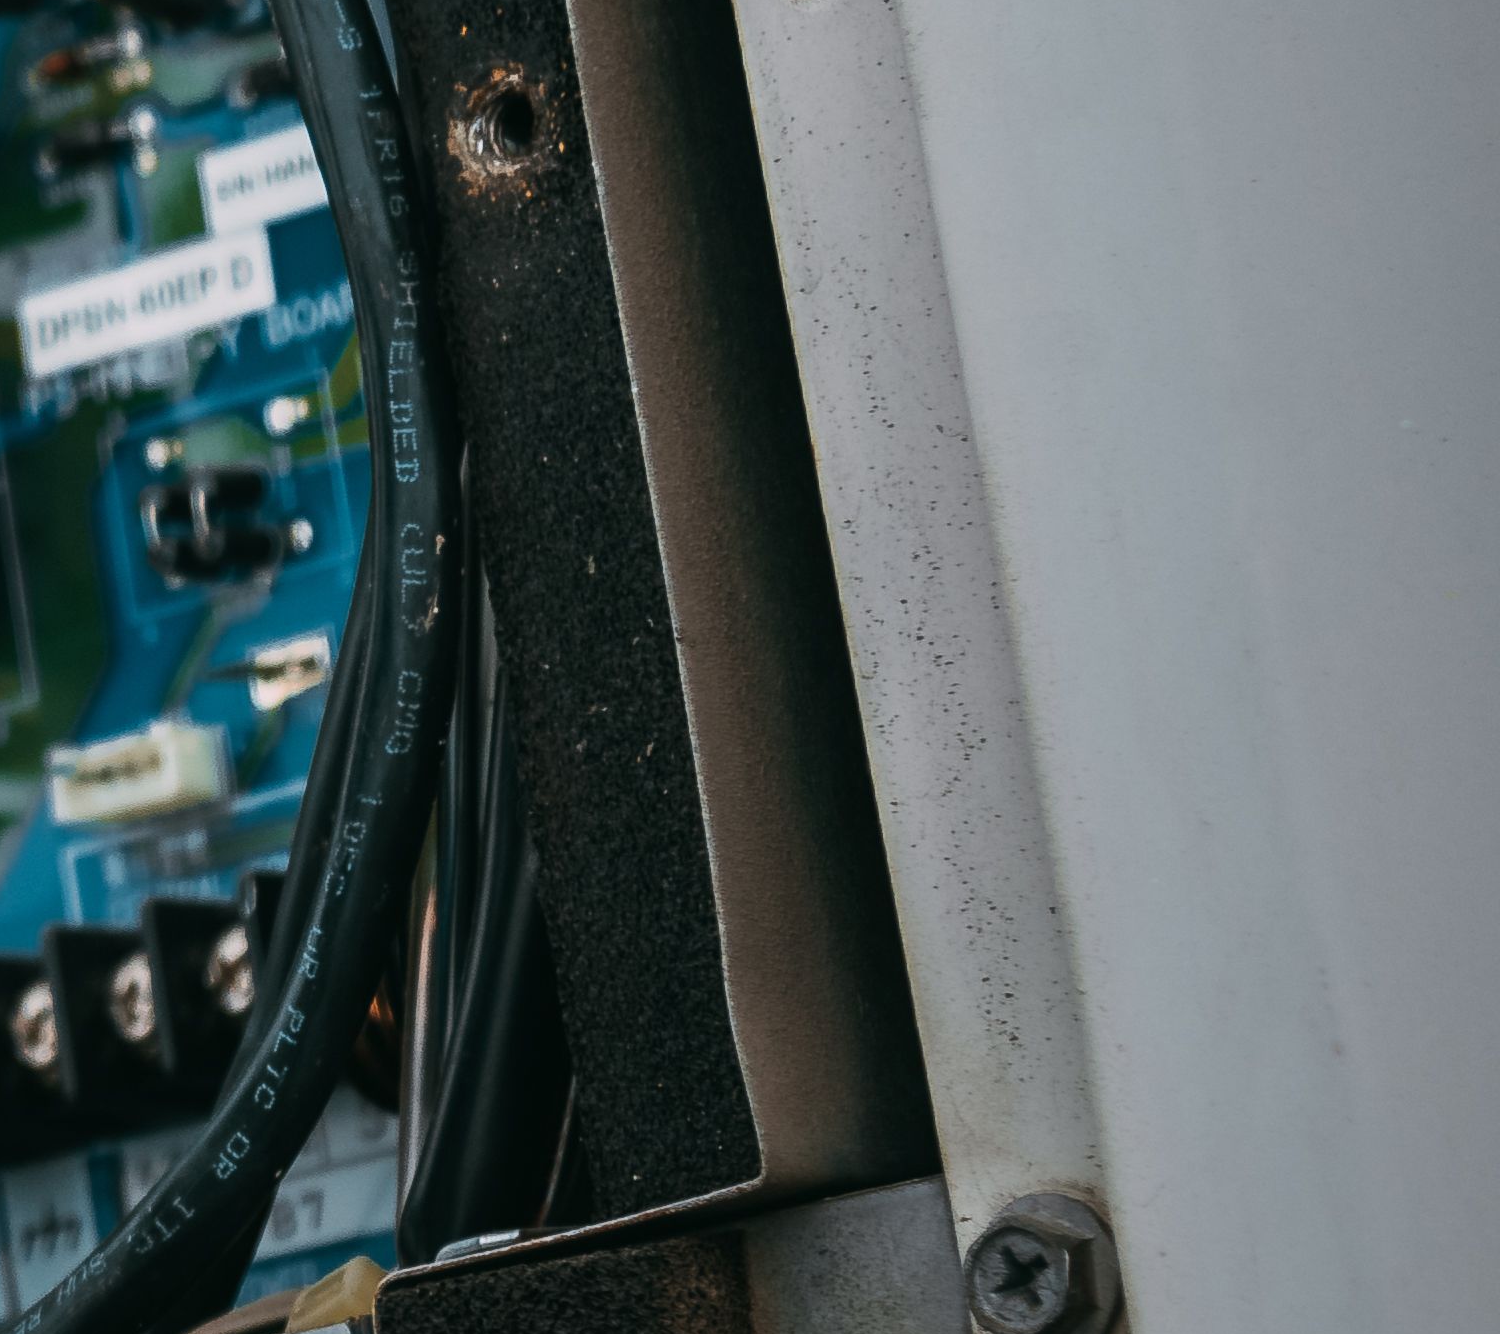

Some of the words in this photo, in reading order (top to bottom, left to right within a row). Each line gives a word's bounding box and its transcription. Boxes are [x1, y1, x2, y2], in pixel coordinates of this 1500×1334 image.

[388, 250, 420, 483] SHIELDED
[255, 1007, 304, 1110] PLTC
[213, 1130, 251, 1180] OR
